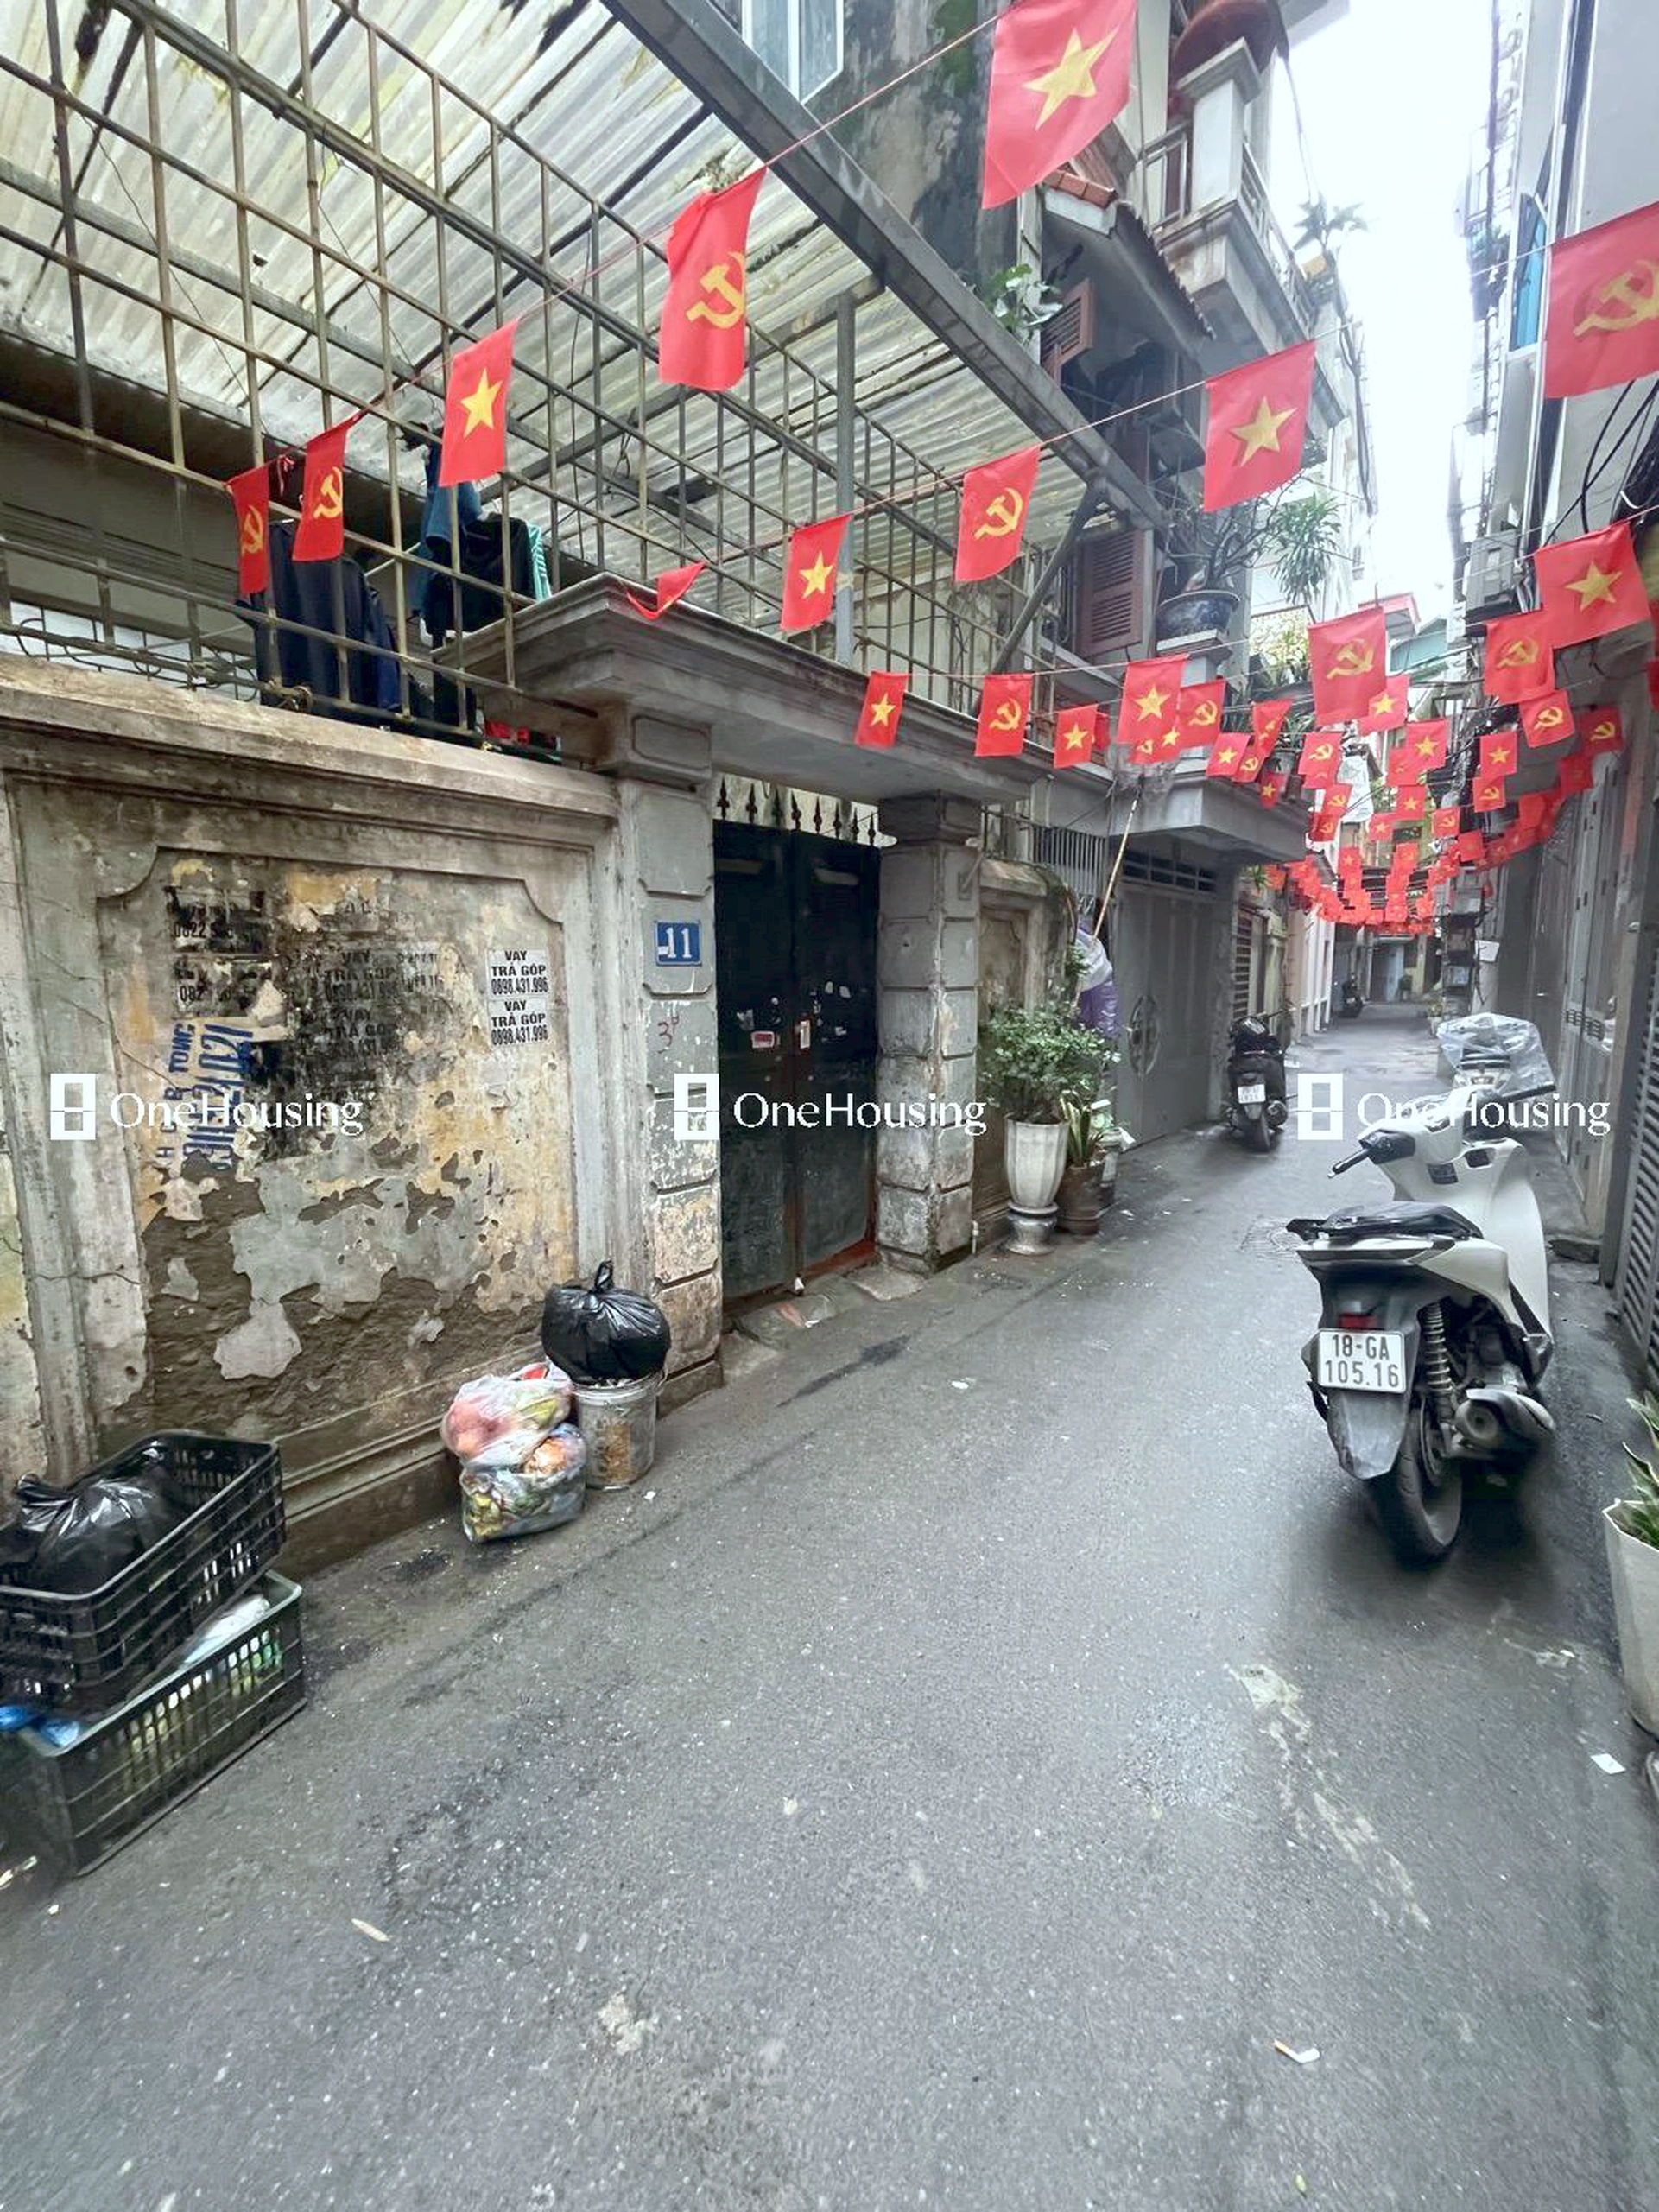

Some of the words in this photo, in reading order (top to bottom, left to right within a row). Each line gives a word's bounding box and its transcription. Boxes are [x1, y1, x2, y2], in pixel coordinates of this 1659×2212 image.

[665, 927, 693, 959] 11
[503, 950, 528, 961] VAY
[491, 961, 516, 977] TRẢ
[521, 962, 547, 976] GÓP
[503, 999, 527, 1011] VAY
[491, 1011, 516, 1028] TRẢ
[521, 1011, 546, 1025] GÓP
[1332, 1334, 1390, 1360] 18-GA
[1325, 1360, 1399, 1388] 105.16
